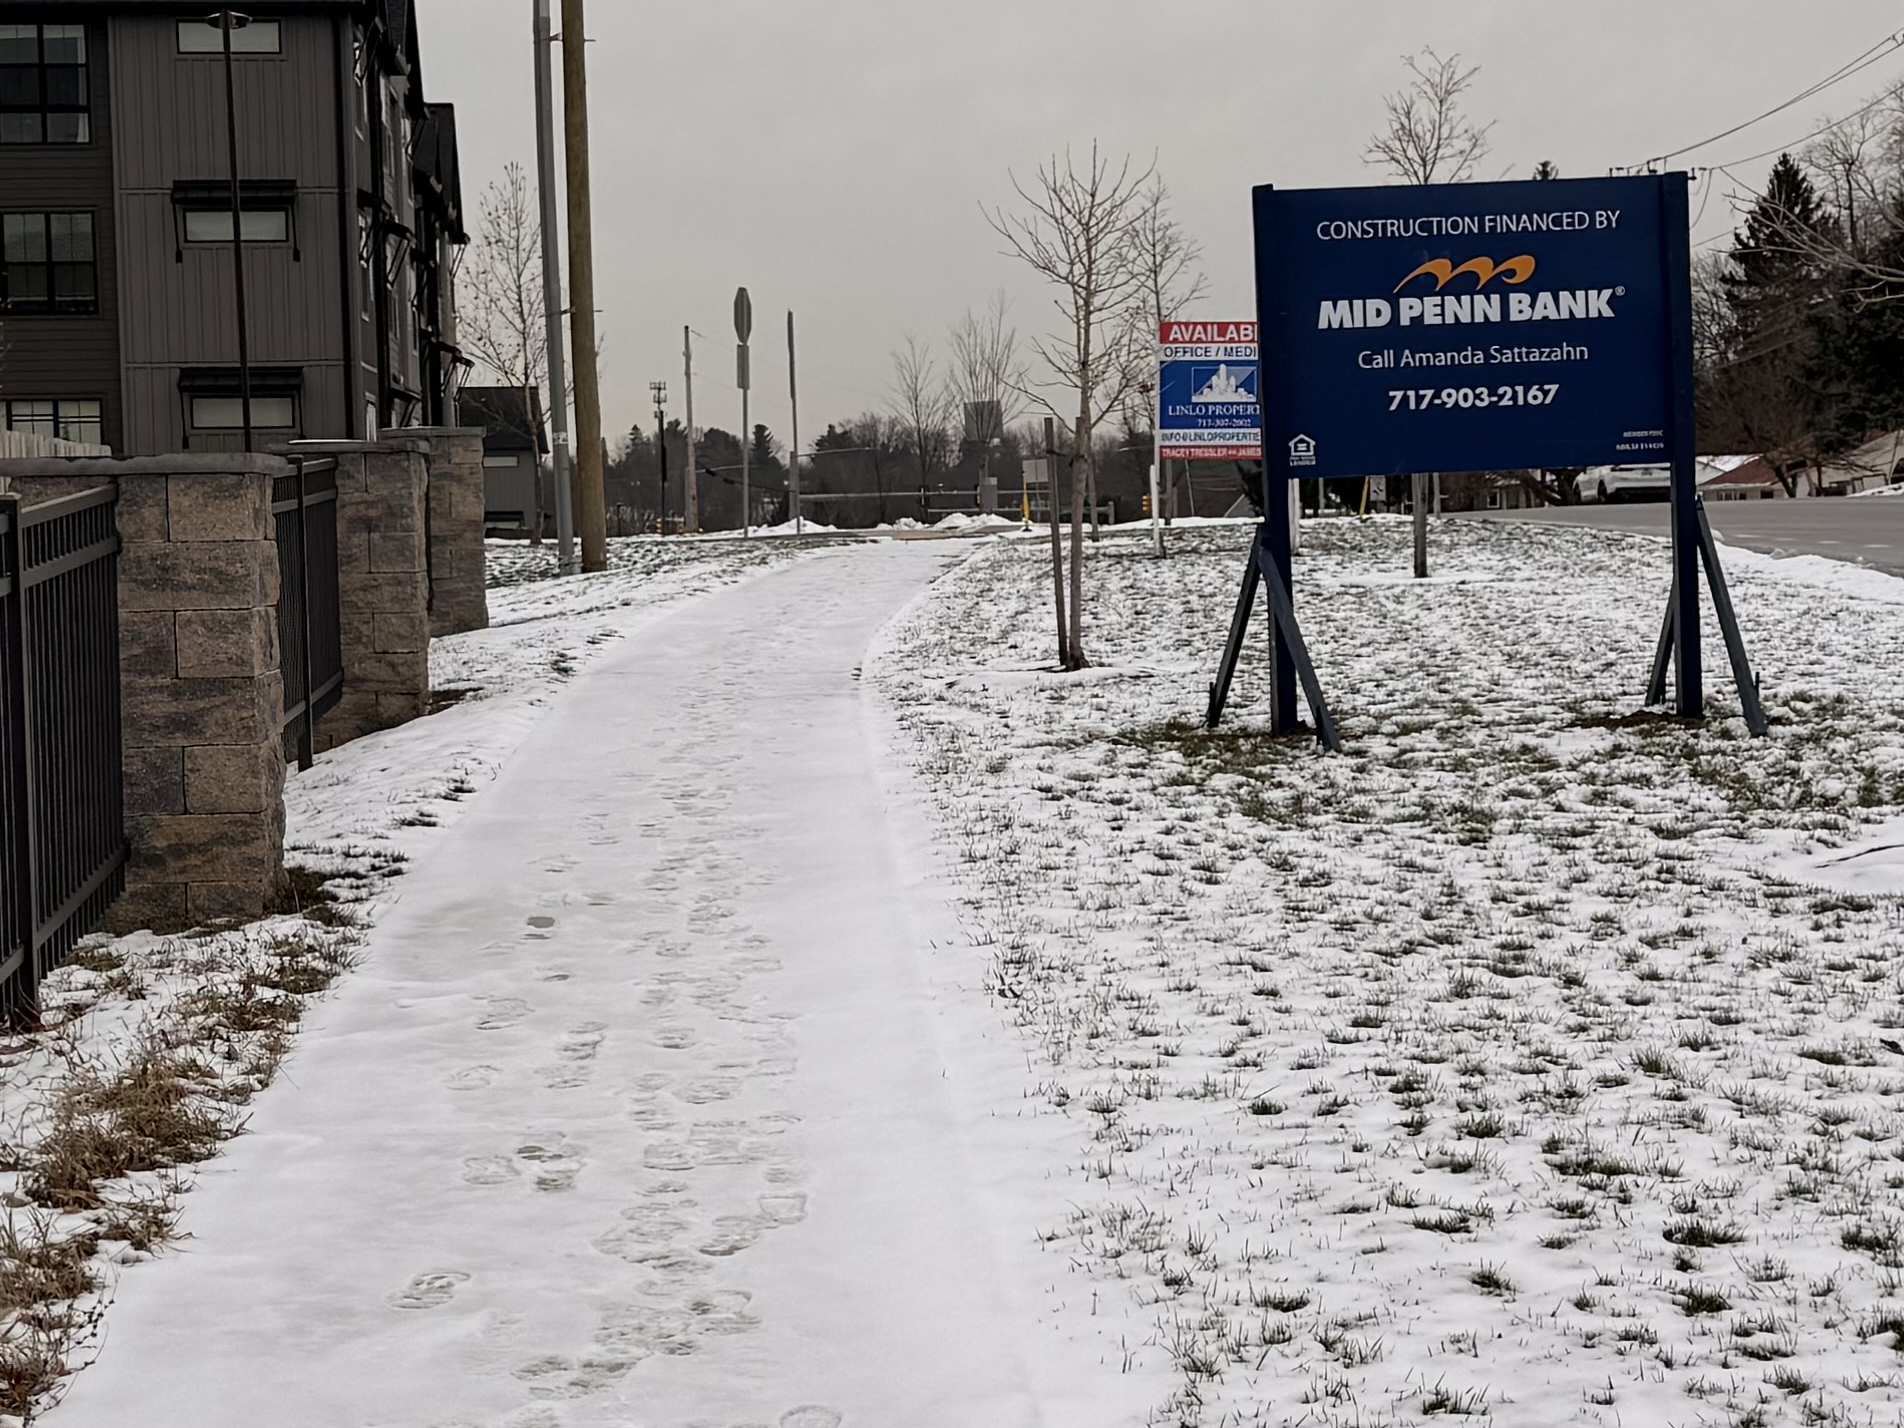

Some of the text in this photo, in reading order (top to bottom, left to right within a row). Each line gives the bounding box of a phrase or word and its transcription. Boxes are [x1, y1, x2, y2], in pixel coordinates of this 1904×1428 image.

[1316, 210, 1621, 240] CONSTRUCTION FINANCED BY
[1317, 298, 1392, 330] MID
[1398, 293, 1502, 326] PENN
[1163, 345, 1212, 358] OFFICE
[1358, 342, 1589, 369] Call Amanda Sattazahn
[1168, 404, 1205, 416] LINLO
[1388, 384, 1560, 411] 717-903-2167
